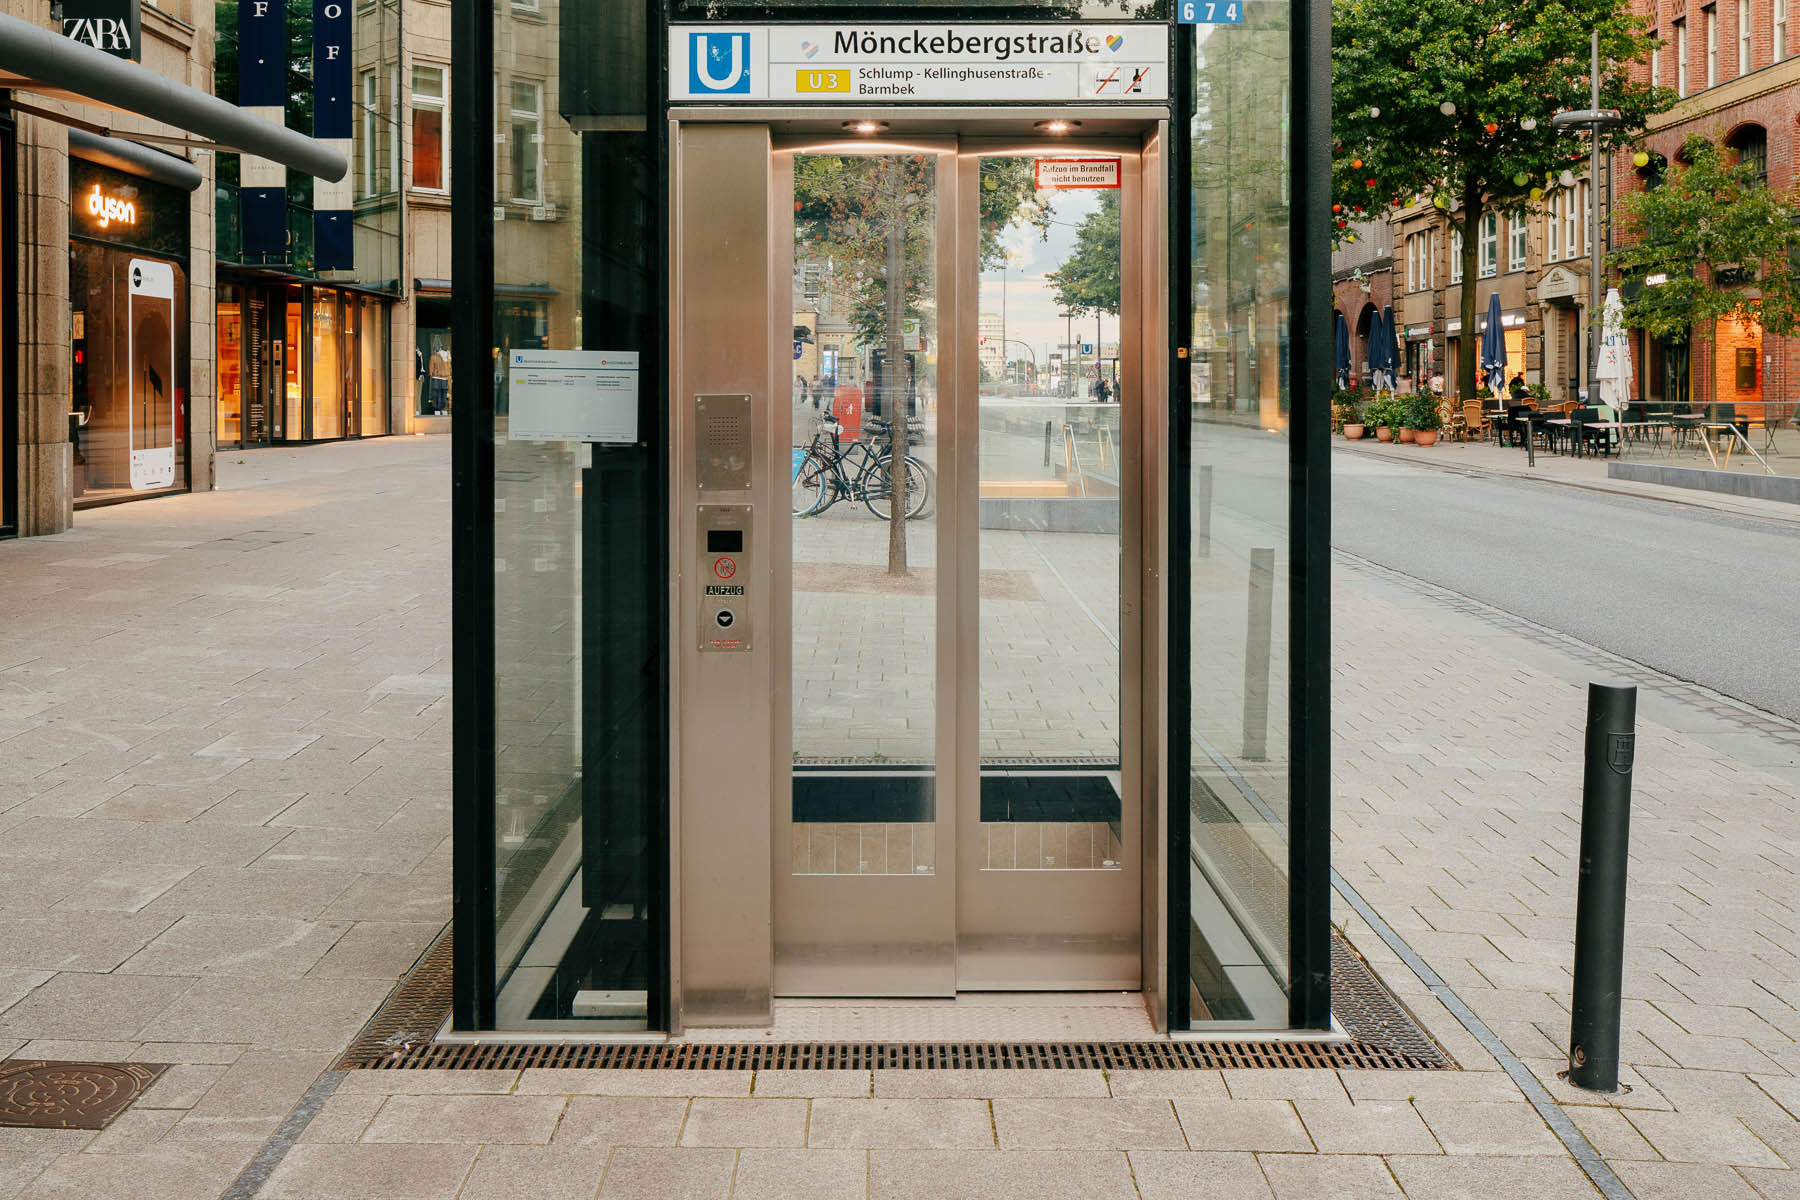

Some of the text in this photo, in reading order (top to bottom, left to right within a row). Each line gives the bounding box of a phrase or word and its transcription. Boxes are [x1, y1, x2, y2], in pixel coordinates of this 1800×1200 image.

[63, 17, 131, 50] ZARA
[833, 28, 1101, 60] Mönckebergstraße
[697, 35, 743, 91] U
[859, 67, 914, 81] Schlump
[924, 67, 1044, 82] Kellinghusenstraße
[859, 83, 915, 95] Barmbek
[1070, 165, 1079, 173] im
[1080, 164, 1114, 173] Brandfall
[1052, 175, 1105, 183] nicht benutzen
[88, 184, 136, 228] dyson
[708, 586, 743, 596] AUFZUG
